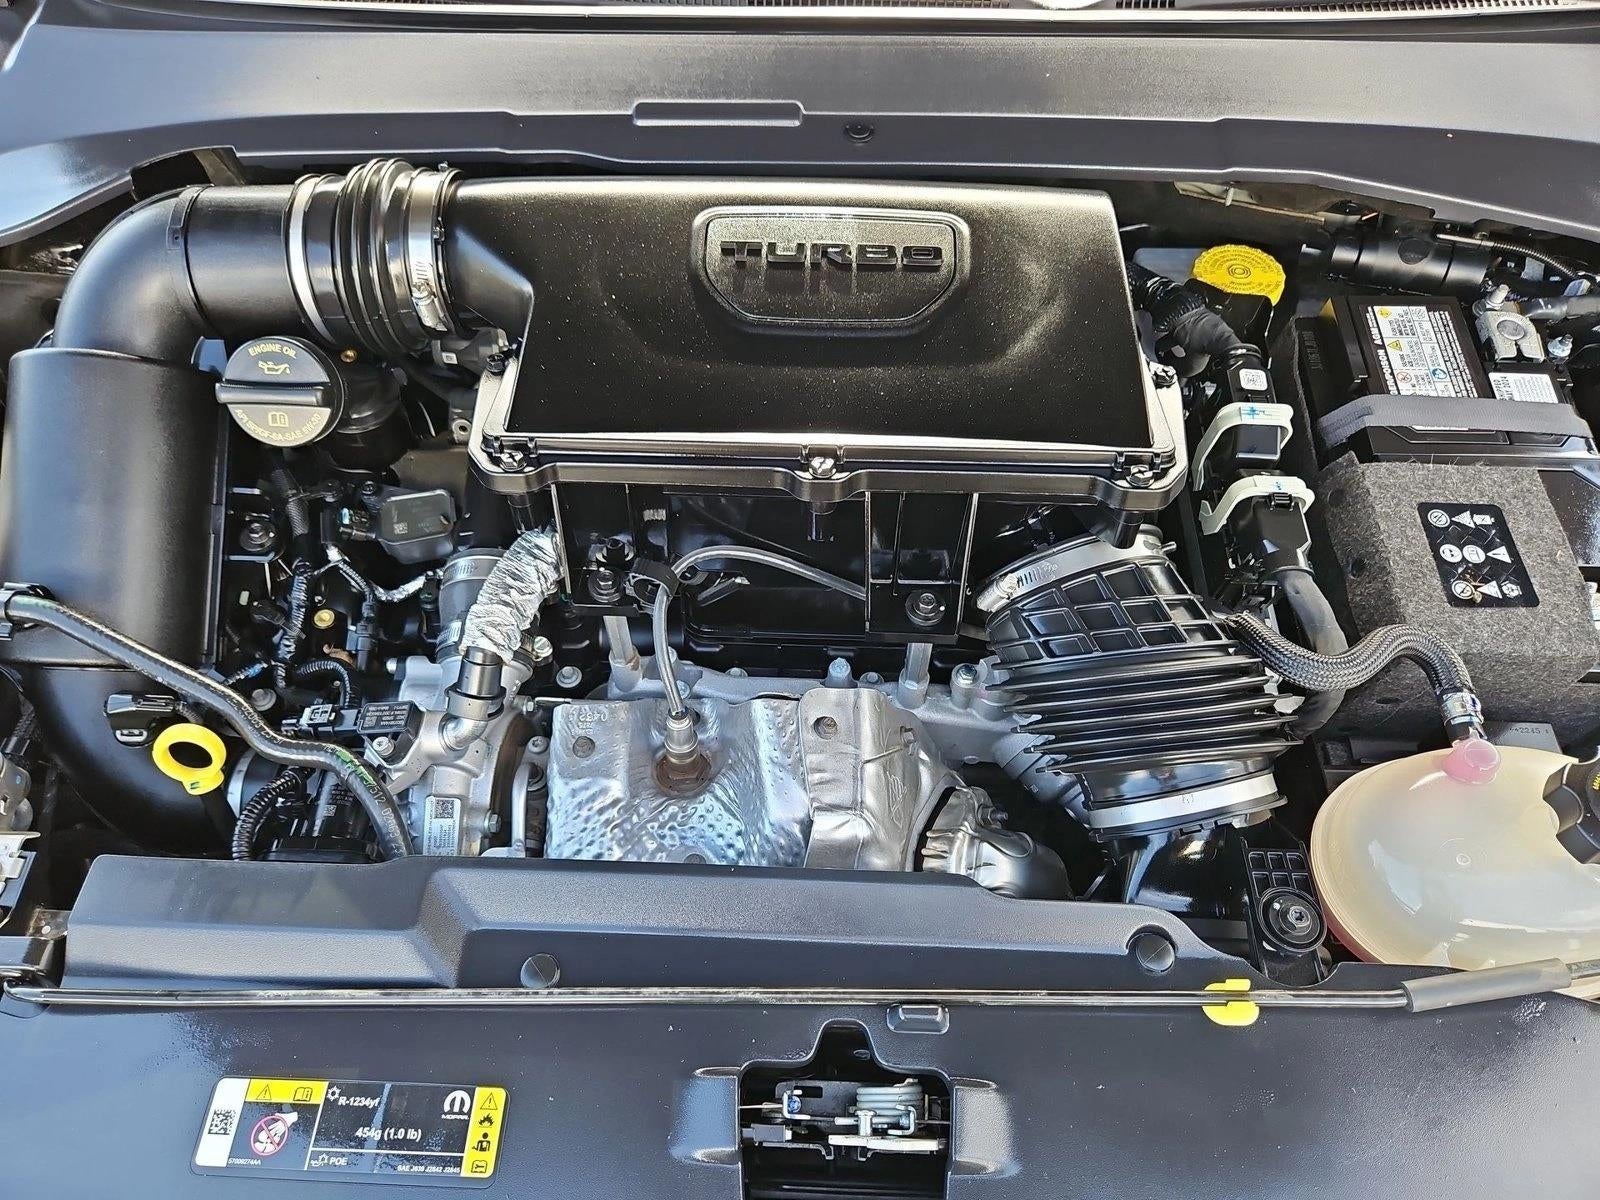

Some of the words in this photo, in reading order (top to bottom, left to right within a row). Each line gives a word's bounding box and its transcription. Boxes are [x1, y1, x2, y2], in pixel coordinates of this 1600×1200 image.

[720, 240, 943, 267] TURBO
[248, 343, 281, 356] ENGINE
[282, 347, 297, 359] OIL
[338, 1096, 380, 1108] R-1234yf
[355, 1126, 382, 1140] 454g
[384, 1128, 404, 1140] (1.0
[406, 1129, 422, 1142] lb)
[329, 1156, 348, 1166] POE
